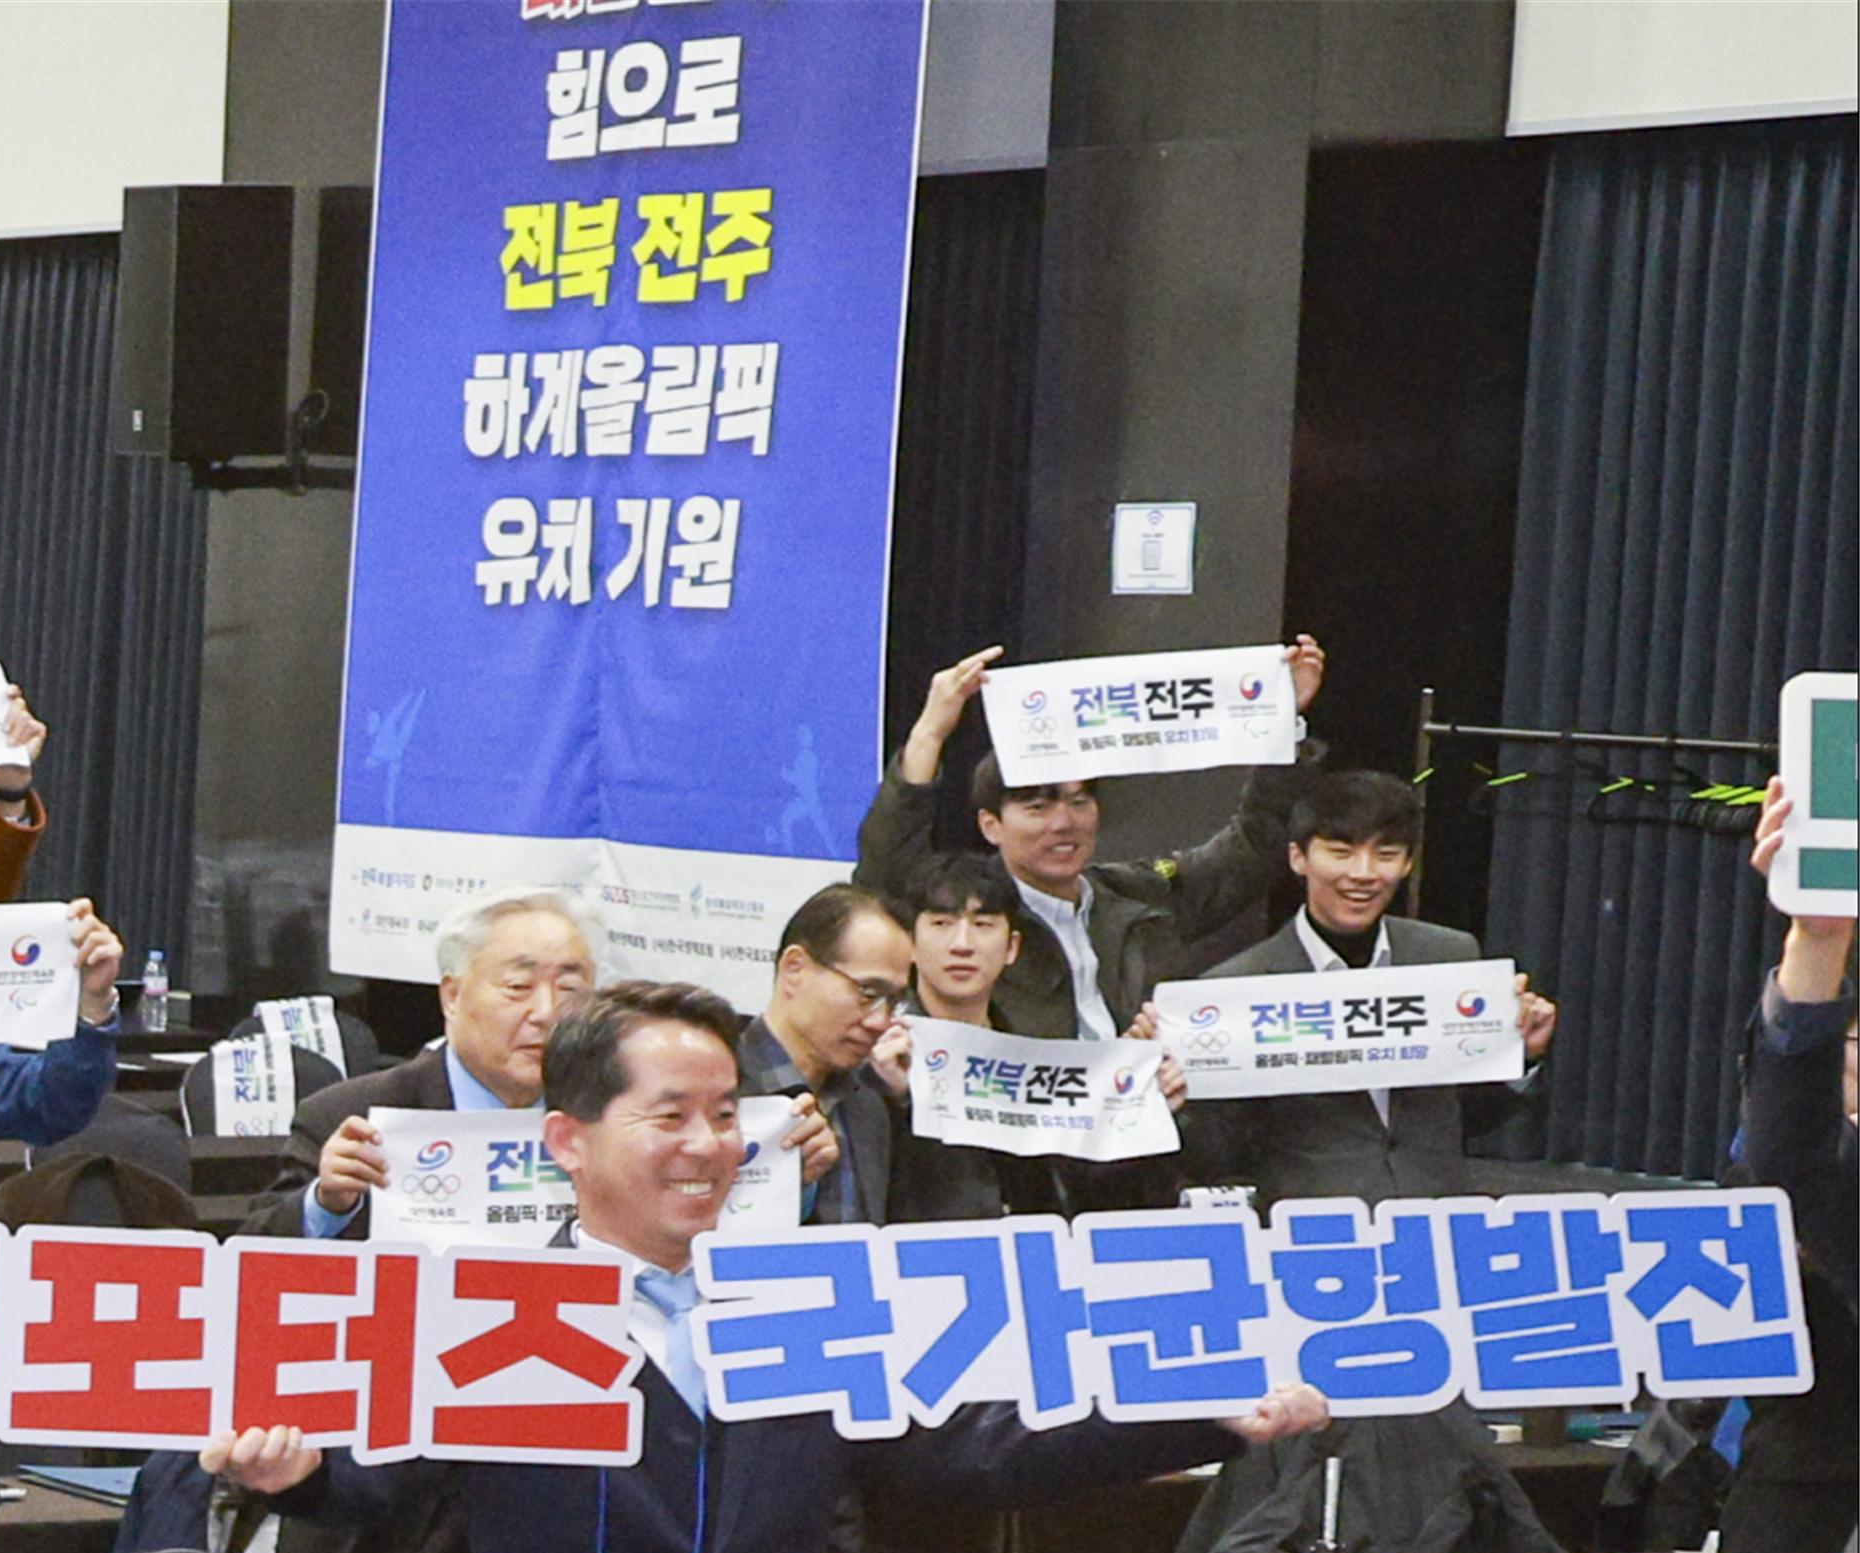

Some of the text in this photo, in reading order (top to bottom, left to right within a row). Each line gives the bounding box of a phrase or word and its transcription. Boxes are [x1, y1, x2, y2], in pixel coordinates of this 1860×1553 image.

[547, 37, 740, 159] 힘으로
[501, 190, 770, 309] 전북 전주
[465, 344, 777, 456] 하계올림픽
[477, 497, 739, 607] 유치 기원
[1071, 678, 1214, 728] 전북 전주
[1250, 995, 1427, 1043] 전북 전주
[1367, 1048, 1395, 1061] 유치
[964, 1056, 1089, 1106] 전북 전주
[707, 1204, 1798, 1425] 국가균형발전
